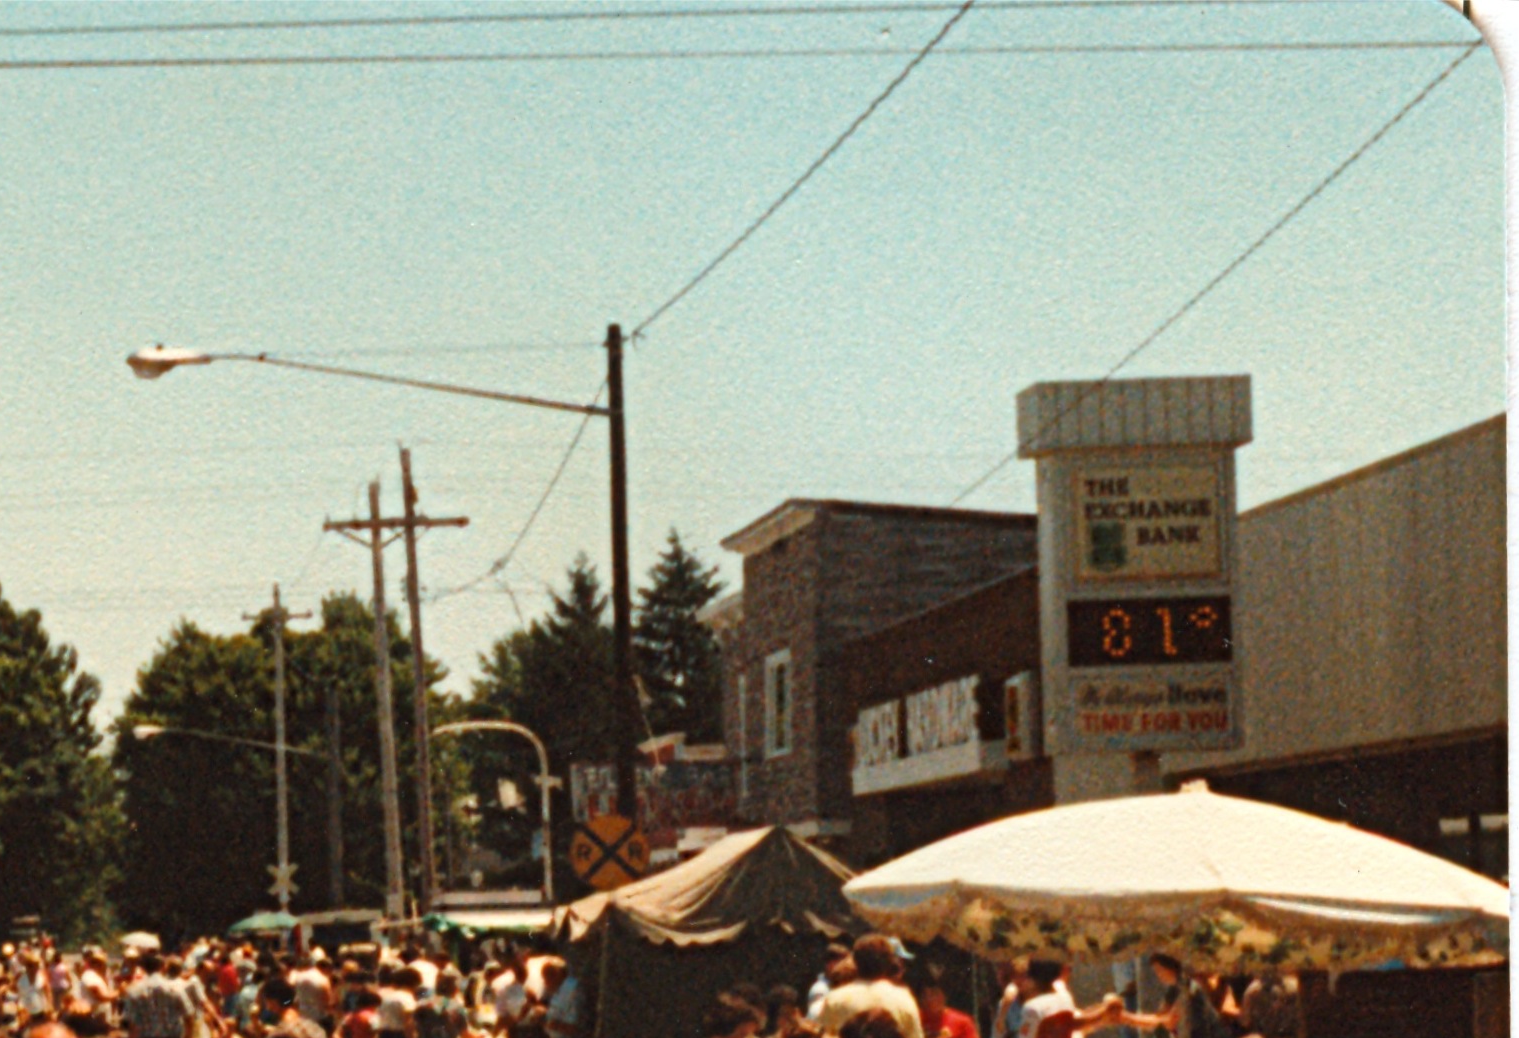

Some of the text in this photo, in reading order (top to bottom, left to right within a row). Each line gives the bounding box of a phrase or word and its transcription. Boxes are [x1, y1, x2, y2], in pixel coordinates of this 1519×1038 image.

[1085, 477, 1129, 497] THE
[1085, 499, 1212, 520] EXCHANGE
[1137, 526, 1201, 546] BANK
[1083, 709, 1228, 734] TIME FOR YOU
